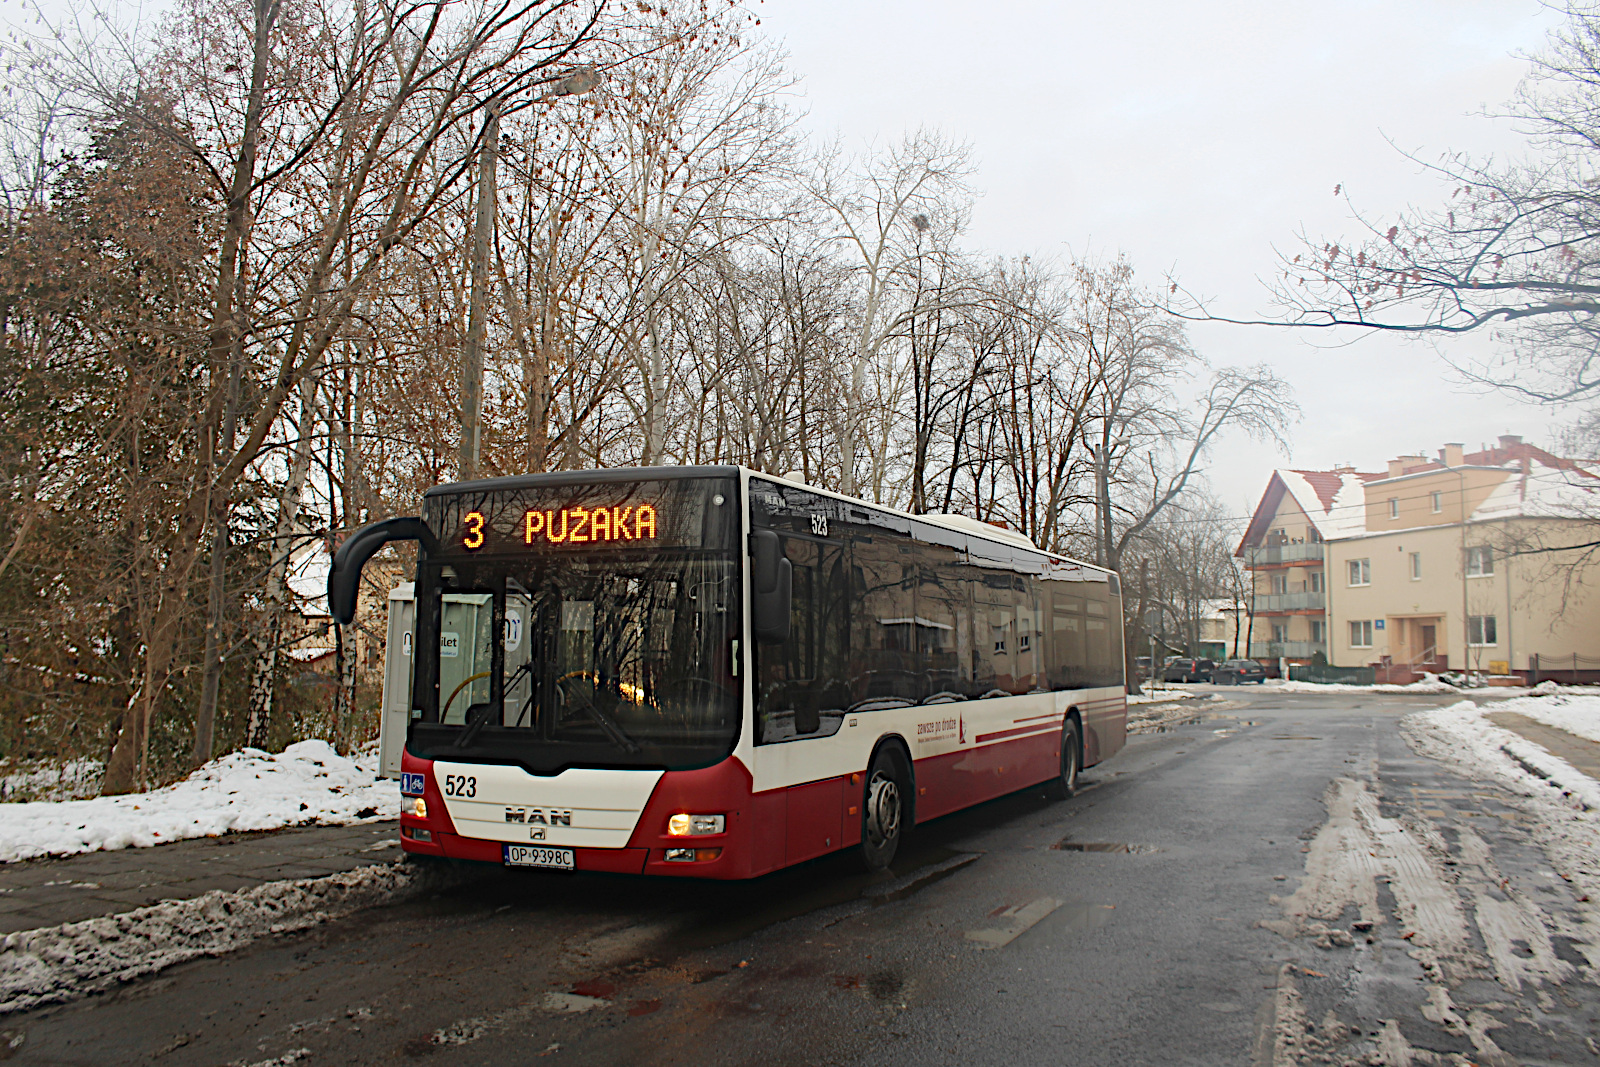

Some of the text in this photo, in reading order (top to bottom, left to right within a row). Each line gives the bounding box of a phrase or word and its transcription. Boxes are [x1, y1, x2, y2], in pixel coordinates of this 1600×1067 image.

[764, 494, 786, 508] MAN
[464, 504, 656, 548] 3 PUŻAKA
[811, 513, 828, 536] 523
[440, 635, 457, 648] ilet
[445, 774, 477, 798] 523
[505, 807, 571, 826] MAN
